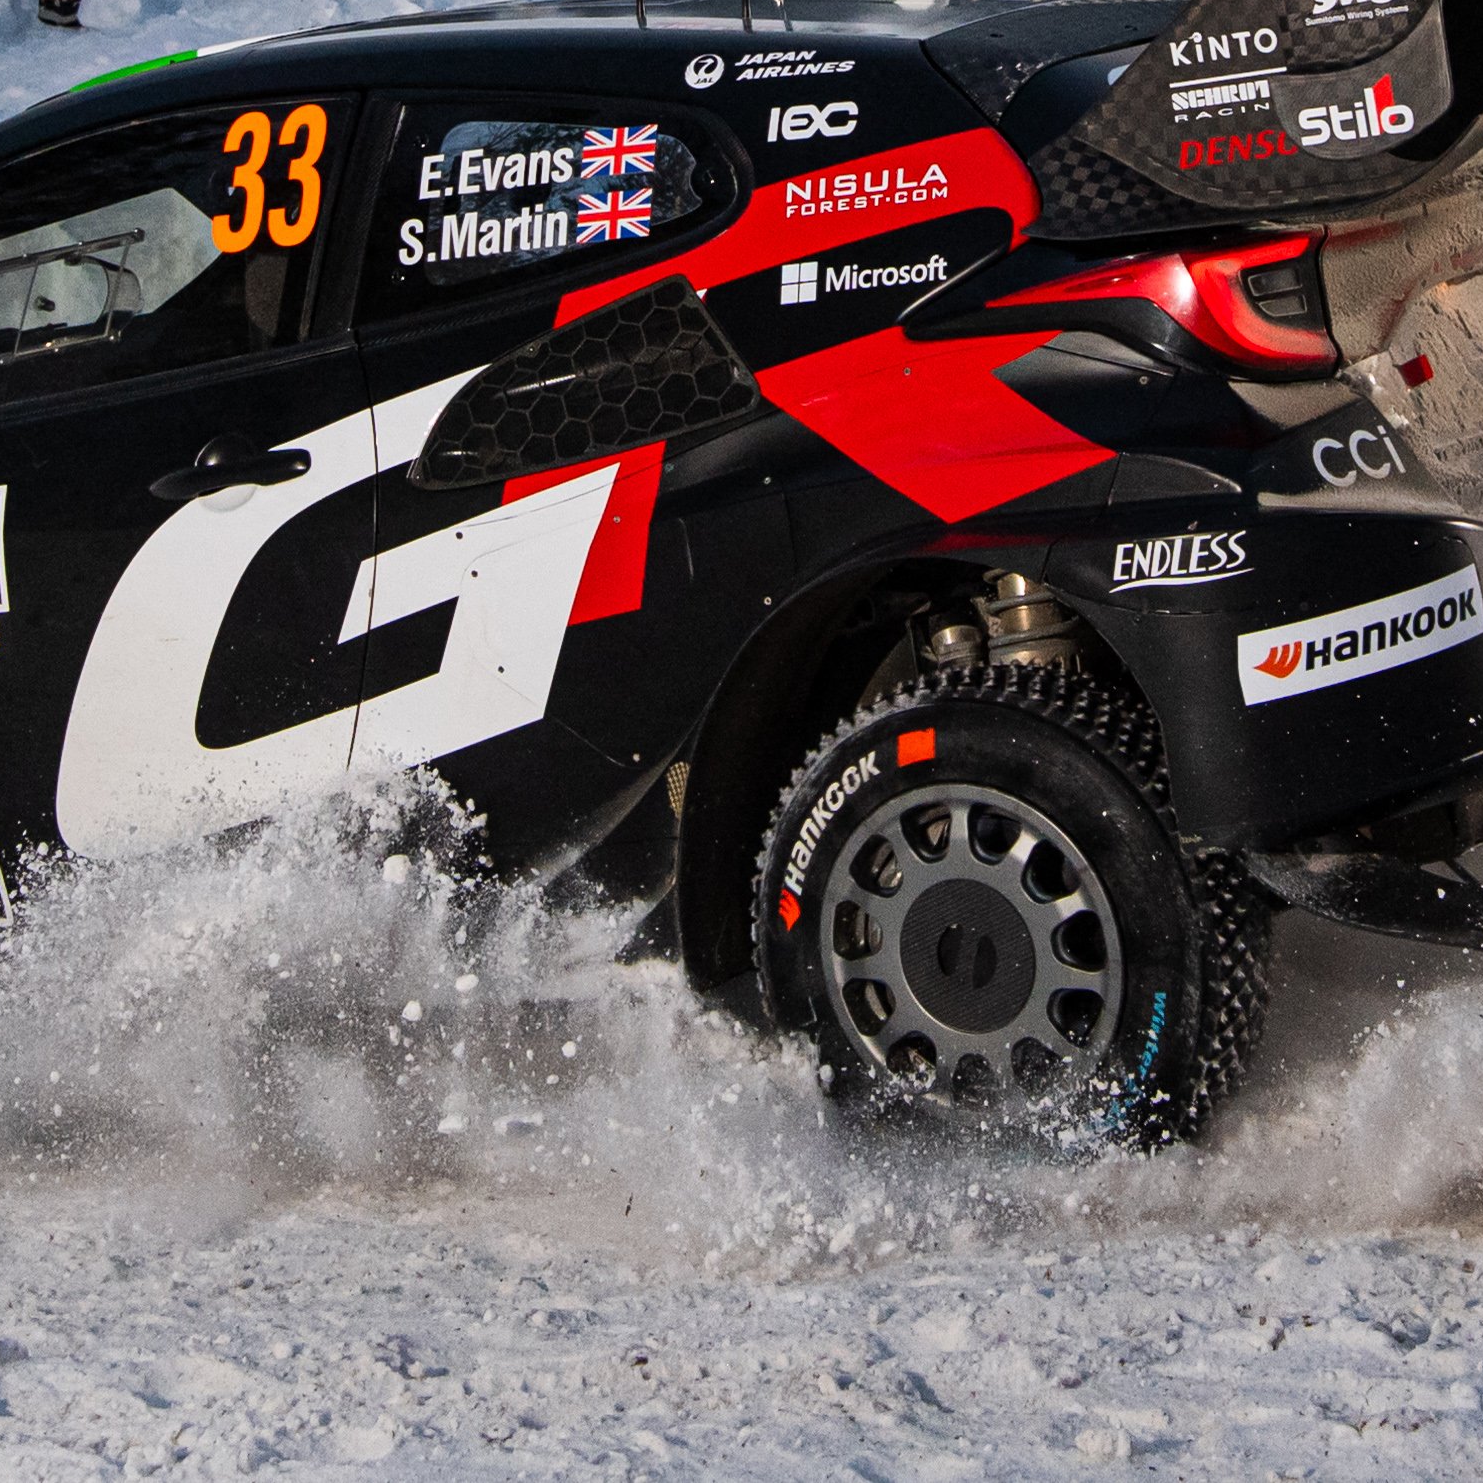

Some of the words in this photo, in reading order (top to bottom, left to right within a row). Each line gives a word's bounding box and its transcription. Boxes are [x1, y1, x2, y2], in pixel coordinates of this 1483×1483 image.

[1305, 14, 1346, 26] Sumitomo
[1346, 9, 1374, 20] Wiring
[1374, 5, 1409, 17] Systems
[735, 50, 817, 66] JAPAN
[736, 60, 856, 81] AIRLINES
[694, 77, 714, 85] JAL
[1171, 79, 1270, 111] SCHROT
[1174, 102, 1270, 123] RACIN
[1298, 74, 1414, 146] Stilo
[212, 103, 328, 255] 33
[419, 147, 574, 200] E.Evans
[786, 164, 948, 203] NISULA
[398, 203, 568, 266] S.Martin
[825, 254, 948, 293] Microsoft
[1113, 529, 1247, 581] ENDLESS
